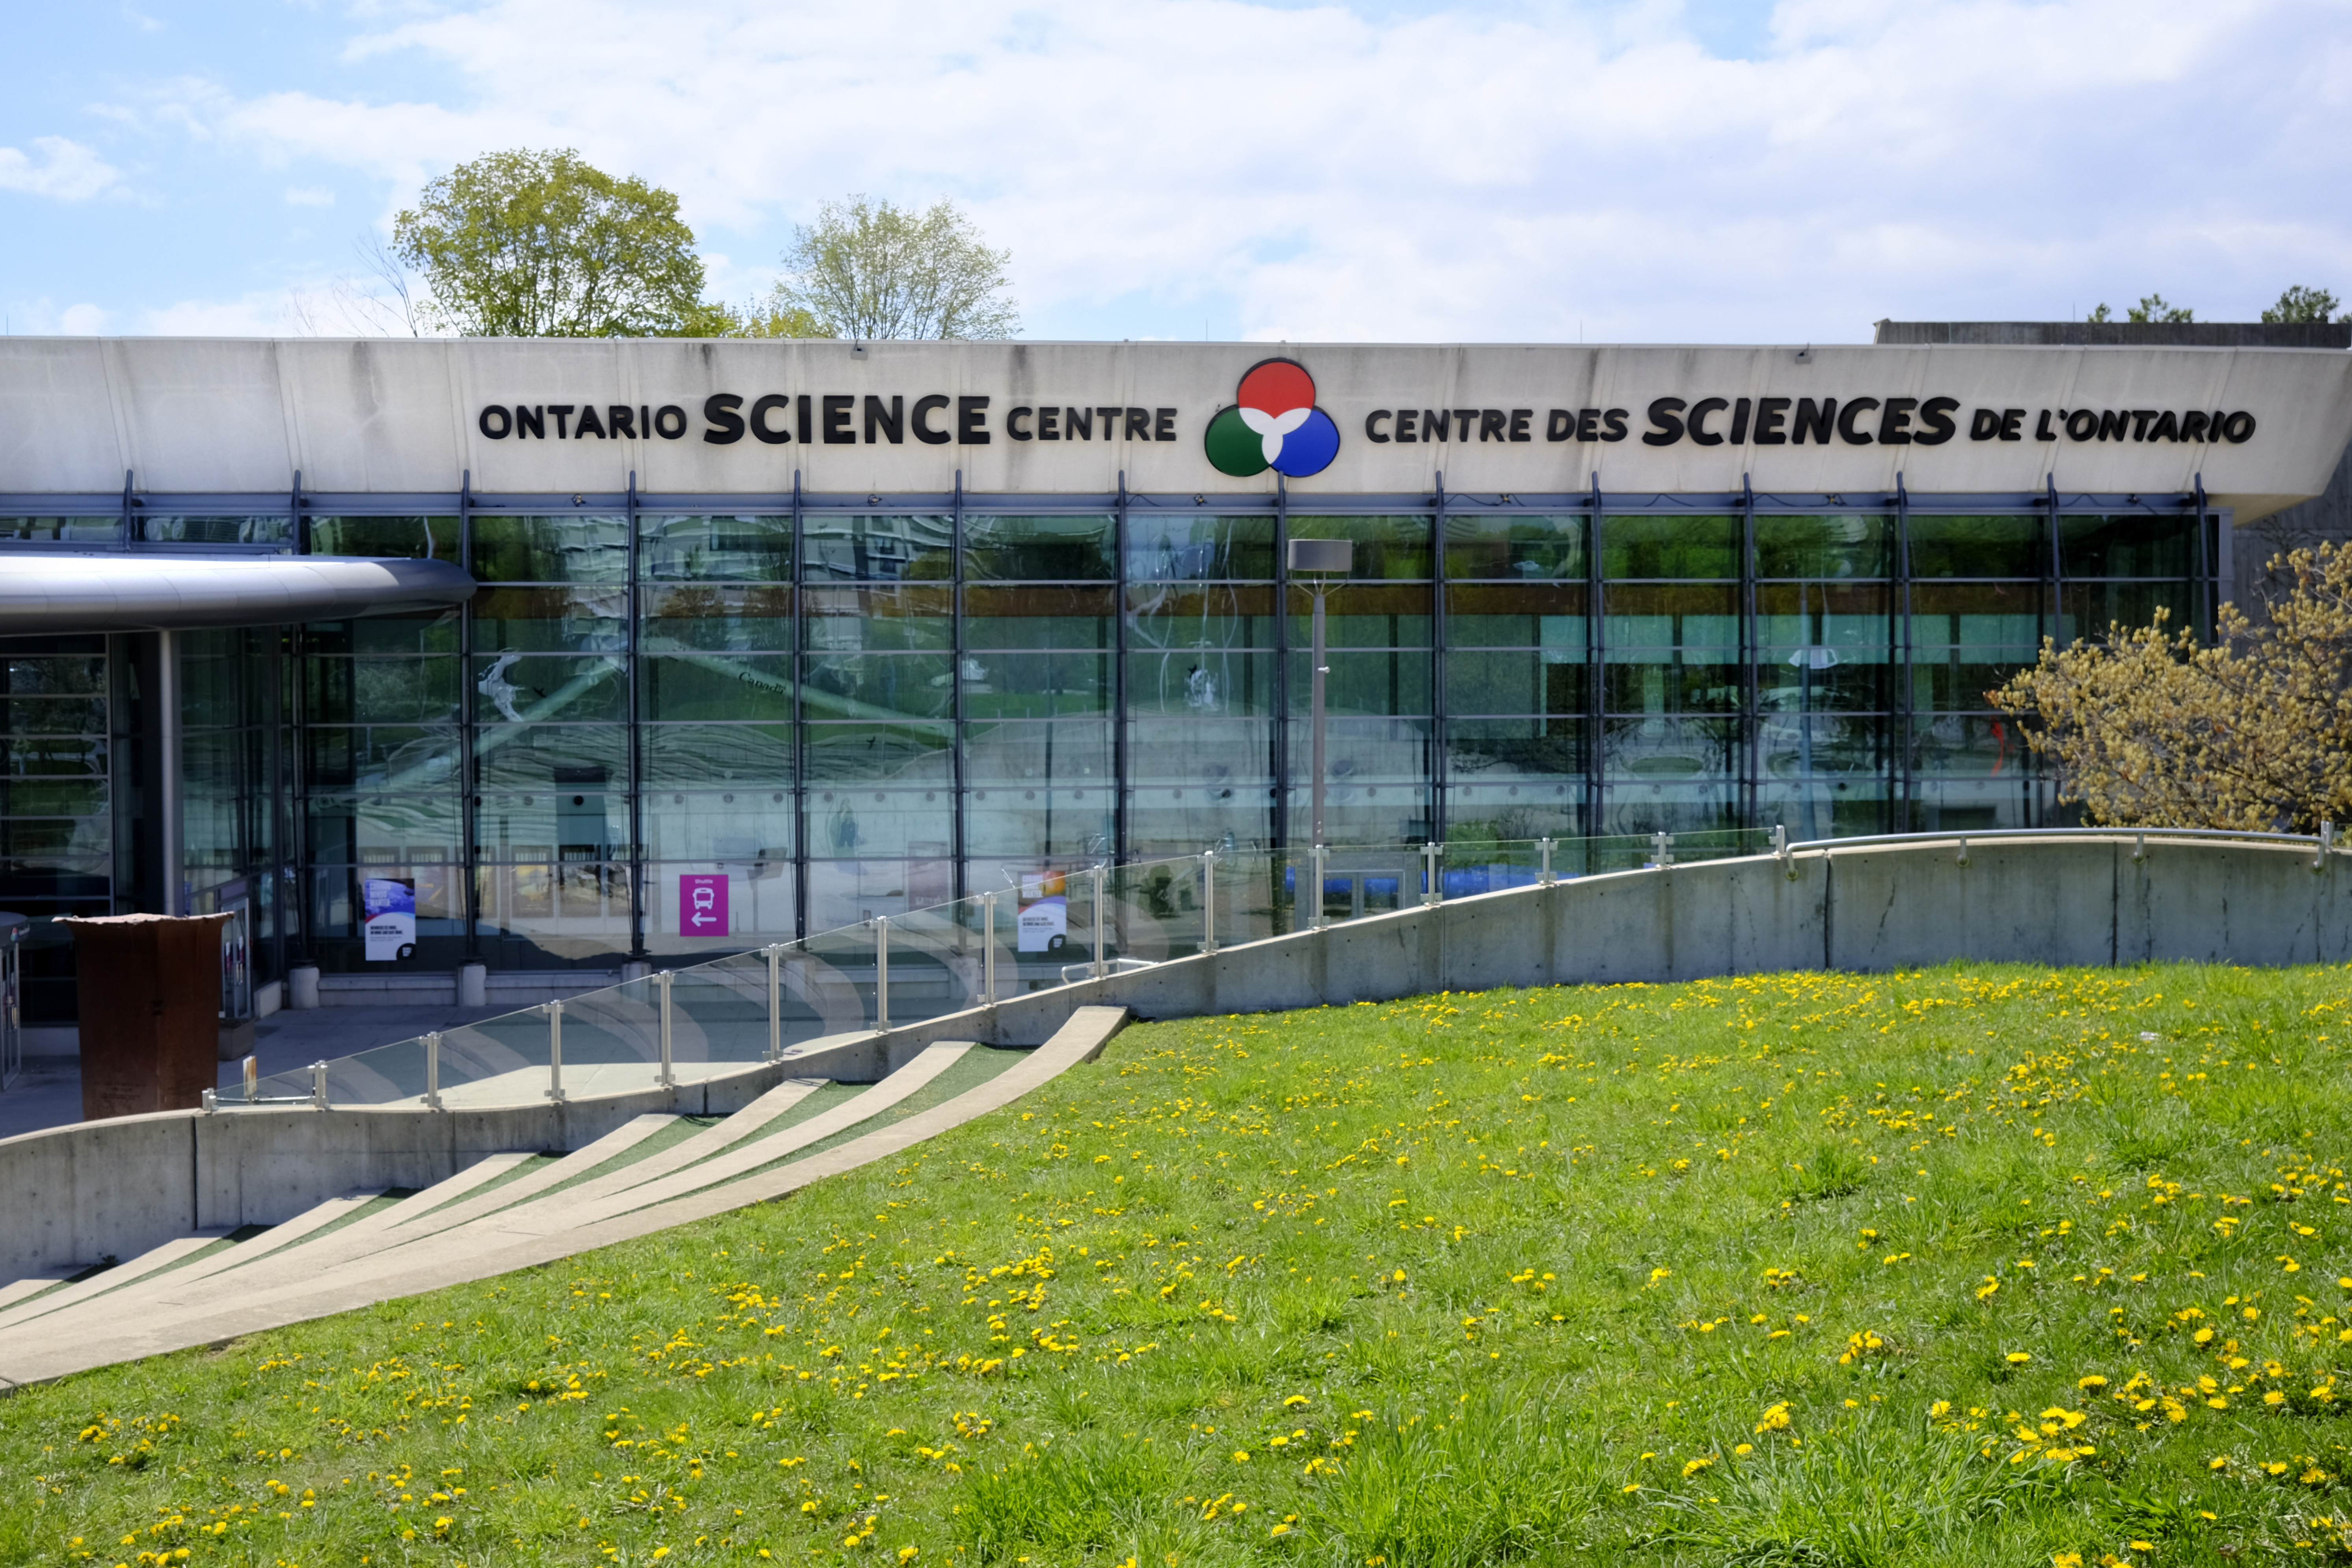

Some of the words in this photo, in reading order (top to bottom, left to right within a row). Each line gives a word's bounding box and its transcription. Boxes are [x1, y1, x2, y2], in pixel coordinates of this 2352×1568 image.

[479, 404, 687, 440] ONTARIO
[703, 393, 991, 445] SCIENCE
[1006, 406, 1177, 441] CENTRE
[1365, 409, 1534, 443] CENTRE
[1546, 408, 1629, 443] DES
[1641, 396, 1961, 447] SCIENCES
[1969, 408, 2027, 441] DE
[2034, 408, 2257, 445] L'ONTARIO
[739, 672, 785, 694] Canada
